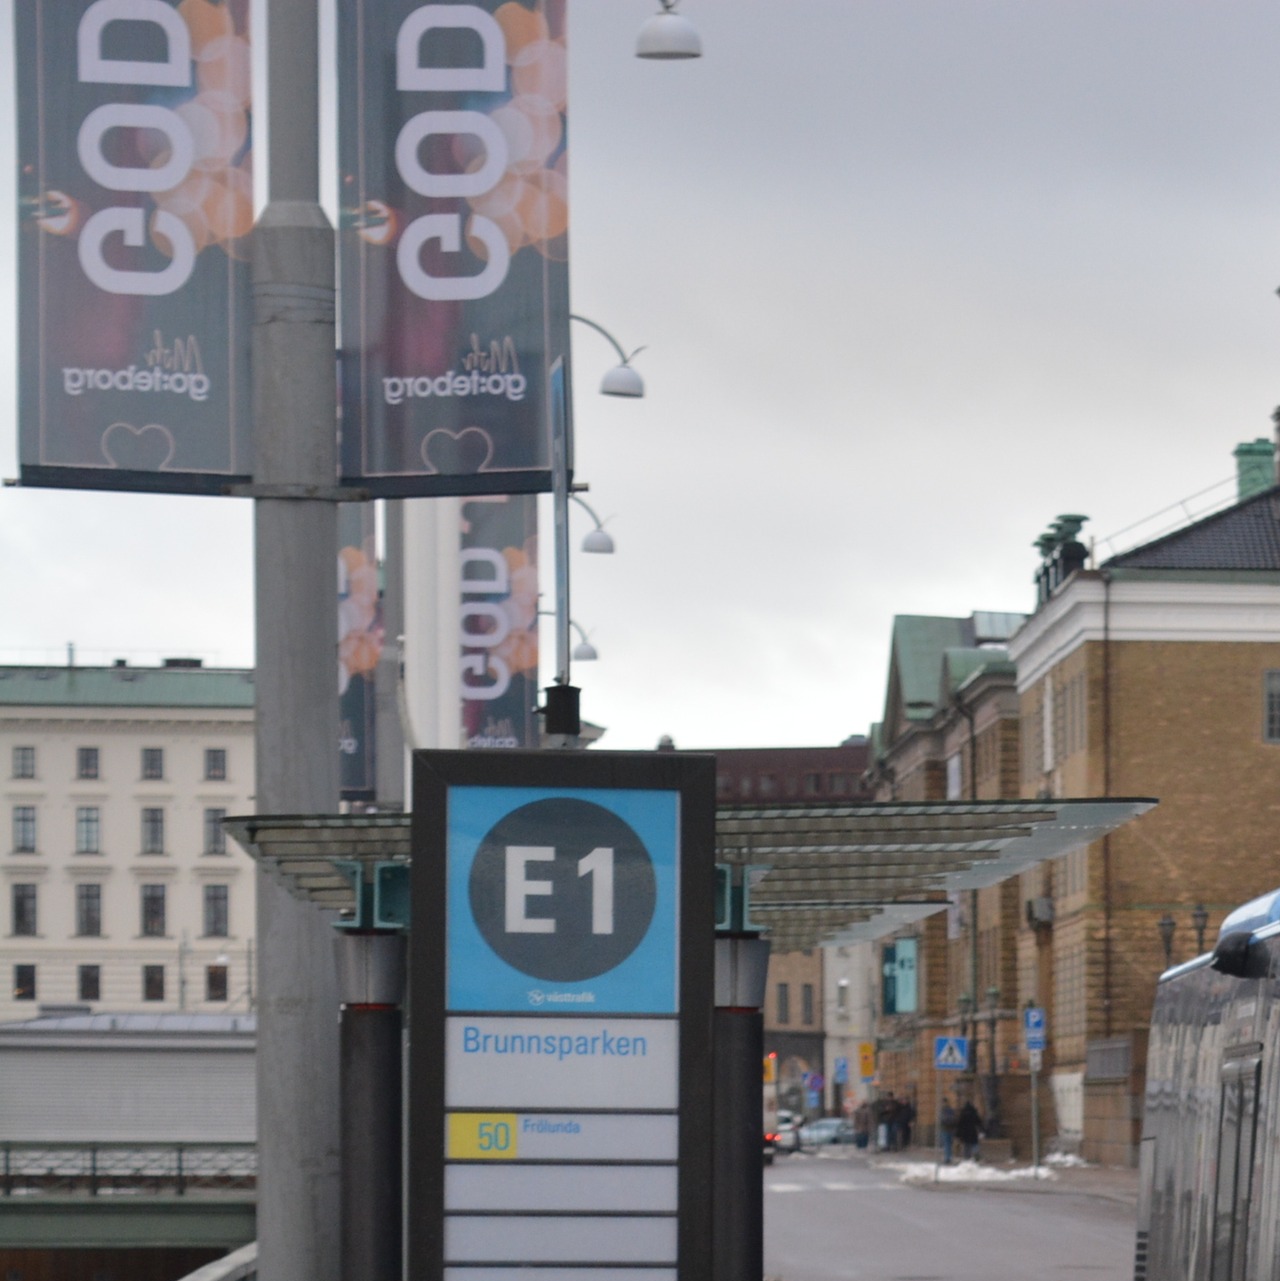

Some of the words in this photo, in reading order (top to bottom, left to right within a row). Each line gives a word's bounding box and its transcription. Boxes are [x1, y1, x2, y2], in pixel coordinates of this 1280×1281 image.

[463, 1026, 648, 1061] Brunnsparken
[478, 1122, 511, 1151] 50
[522, 1118, 581, 1134] Frölunda
